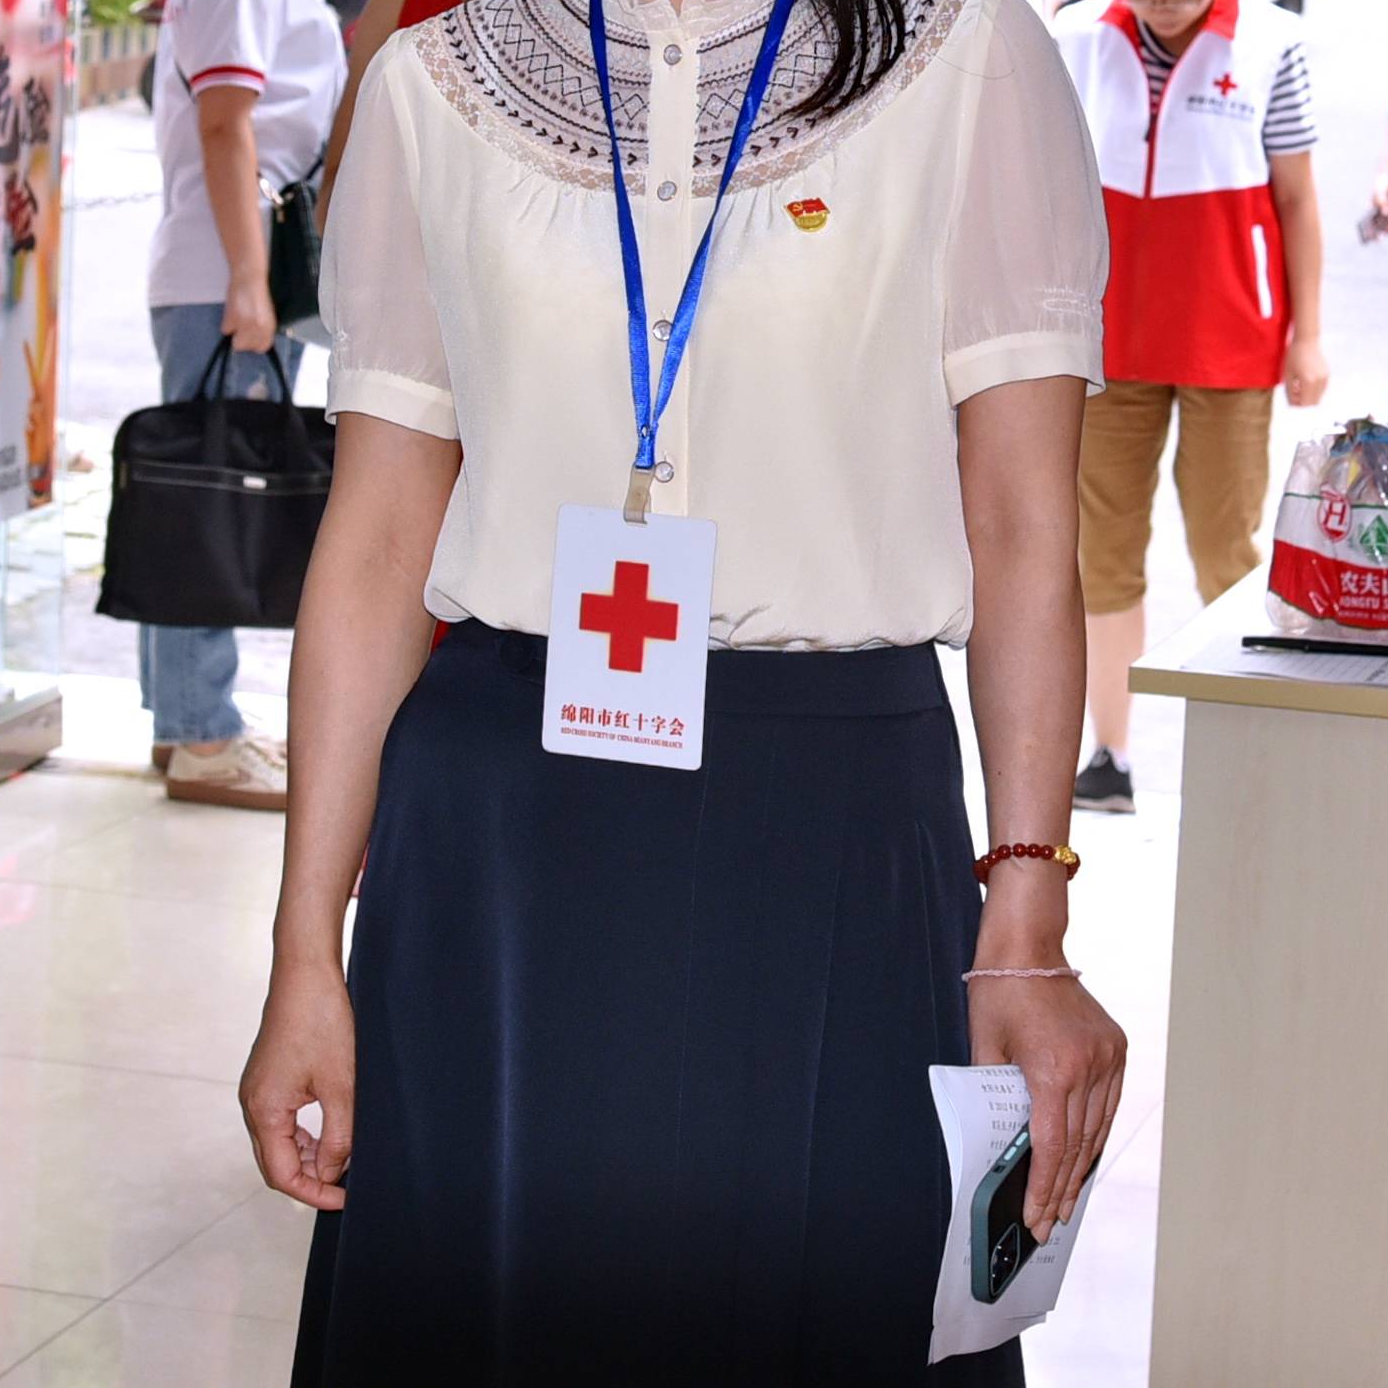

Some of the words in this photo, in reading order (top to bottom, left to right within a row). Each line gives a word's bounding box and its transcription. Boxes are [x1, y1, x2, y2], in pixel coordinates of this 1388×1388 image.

[561, 703, 684, 736] 绵阳市红十字会
